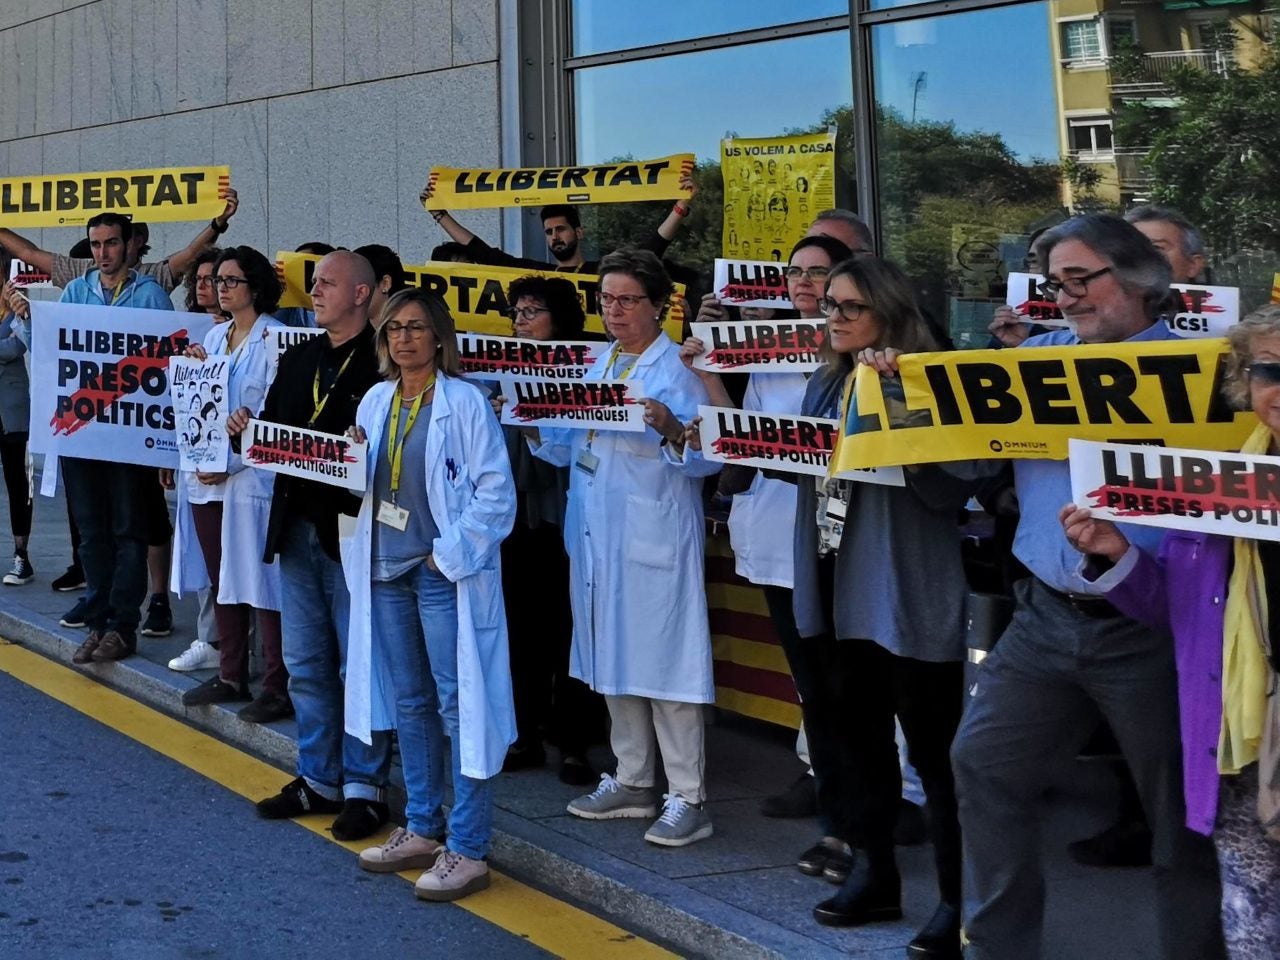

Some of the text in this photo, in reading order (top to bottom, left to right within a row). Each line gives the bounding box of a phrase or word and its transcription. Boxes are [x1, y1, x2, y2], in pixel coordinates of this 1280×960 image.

[725, 142, 833, 157] US VOLEM A CASA
[454, 161, 669, 194] LLIBERTAT
[1, 172, 205, 214] LLIBERTAT
[728, 264, 788, 287] LLIB
[59, 328, 189, 358] LLIBERTAT
[459, 338, 587, 365] LIBERTAT
[716, 351, 771, 365] PRESES
[58, 358, 171, 397] PRESO
[514, 382, 626, 407] LLIBERTAT
[56, 394, 176, 431] POLÍTICS
[253, 424, 348, 464] LLIBERTAT
[722, 441, 775, 460] PRESES
[1106, 491, 1204, 518] PRESES
